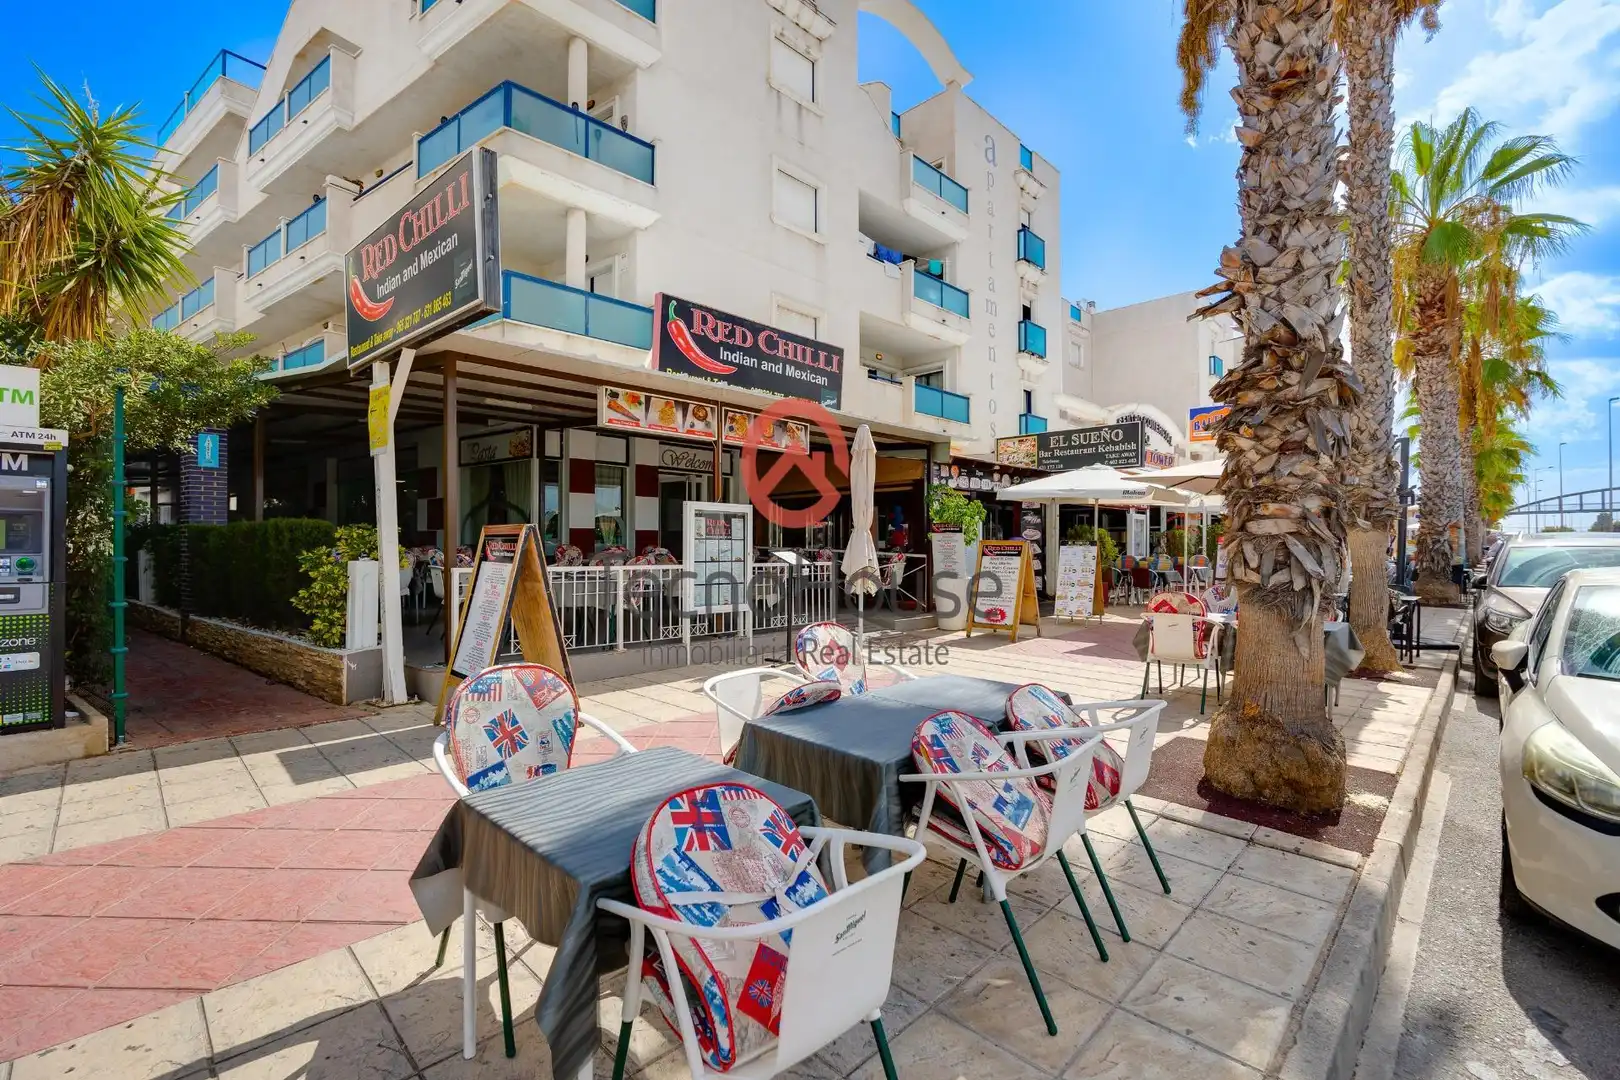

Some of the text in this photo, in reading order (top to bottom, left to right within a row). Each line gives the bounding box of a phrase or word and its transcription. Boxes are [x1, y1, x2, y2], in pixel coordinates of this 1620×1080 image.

[360, 171, 470, 282] RED CHILLI
[376, 233, 458, 299] Indian and Mexican
[984, 134, 998, 438] apartamentos
[690, 308, 840, 374] RED CHILLI
[719, 346, 828, 387] Indian and Mexican
[11, 431, 56, 441] ATM 24h
[1049, 428, 1124, 448] EL SUEÑO
[0, 452, 28, 471] M
[662, 449, 714, 470] Welcom
[1039, 449, 1051, 459] Bar
[1053, 446, 1096, 458] Restaurant
